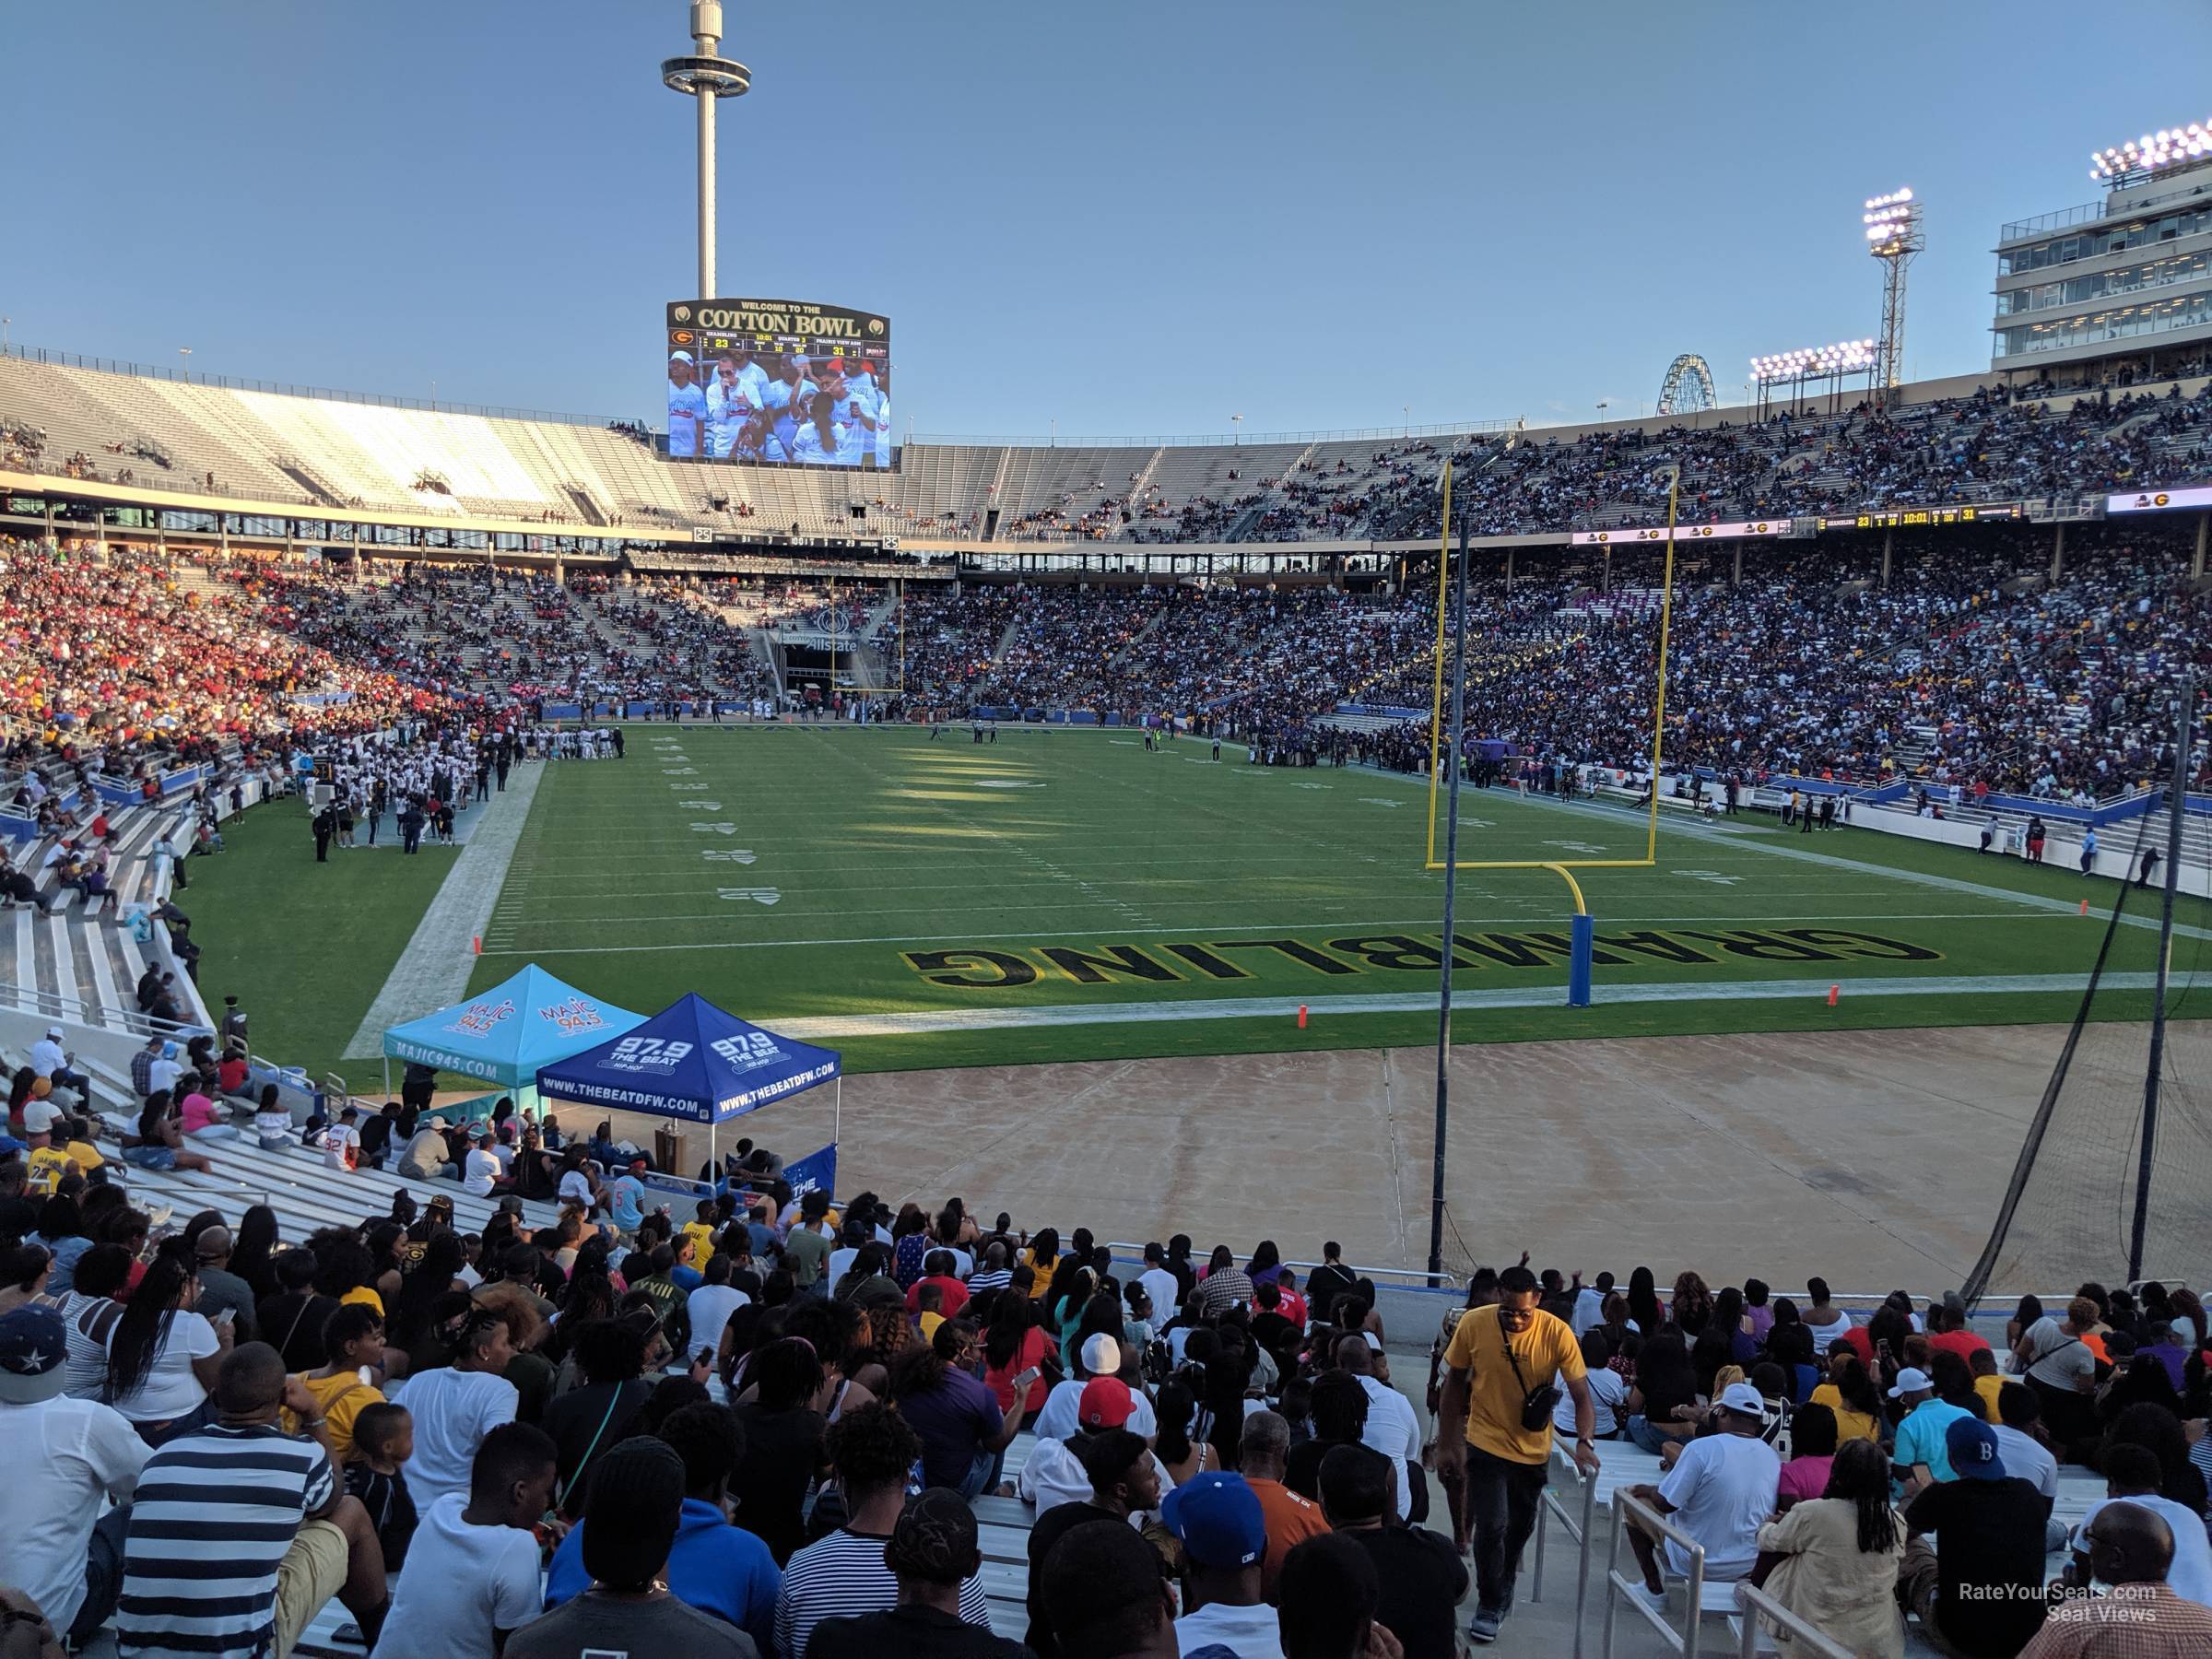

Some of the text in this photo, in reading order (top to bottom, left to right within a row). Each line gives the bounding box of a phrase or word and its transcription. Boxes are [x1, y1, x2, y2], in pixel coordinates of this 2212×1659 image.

[741, 301, 787, 312] WELCOME
[803, 306, 820, 314] THE
[698, 309, 862, 337] COTTON BOWL
[715, 338, 729, 348] 23
[832, 347, 845, 356] 31
[1857, 517, 1869, 527] 23
[1888, 518, 1897, 526] 10
[1903, 512, 1928, 524] 10:01
[1962, 509, 1974, 520] 31
[697, 530, 710, 540] 25
[846, 539, 855, 547] 23
[885, 537, 898, 548] 25
[806, 638, 857, 652] Allstate
[899, 928, 1948, 991] GRAMBLING
[465, 1000, 515, 1021] MAJIC
[539, 997, 598, 1021] MAJIC
[457, 1015, 496, 1031] 94.5
[558, 1014, 602, 1030] 94.5
[614, 1037, 694, 1059] 97.9
[710, 1031, 775, 1057] 97.9
[396, 1041, 498, 1080] MAJIC945.COM
[610, 1052, 680, 1066] THE BEAT
[726, 1046, 781, 1065] THE BEAT
[719, 1061, 836, 1112] WWW.THEBEATDFW.COM
[543, 1077, 699, 1113] WWW.THEBEATDFW.COM
[793, 1176, 817, 1197] THE
[616, 1191, 624, 1207] 5
[409, 1248, 424, 1260] G
[1979, 1441, 1993, 1461] B
